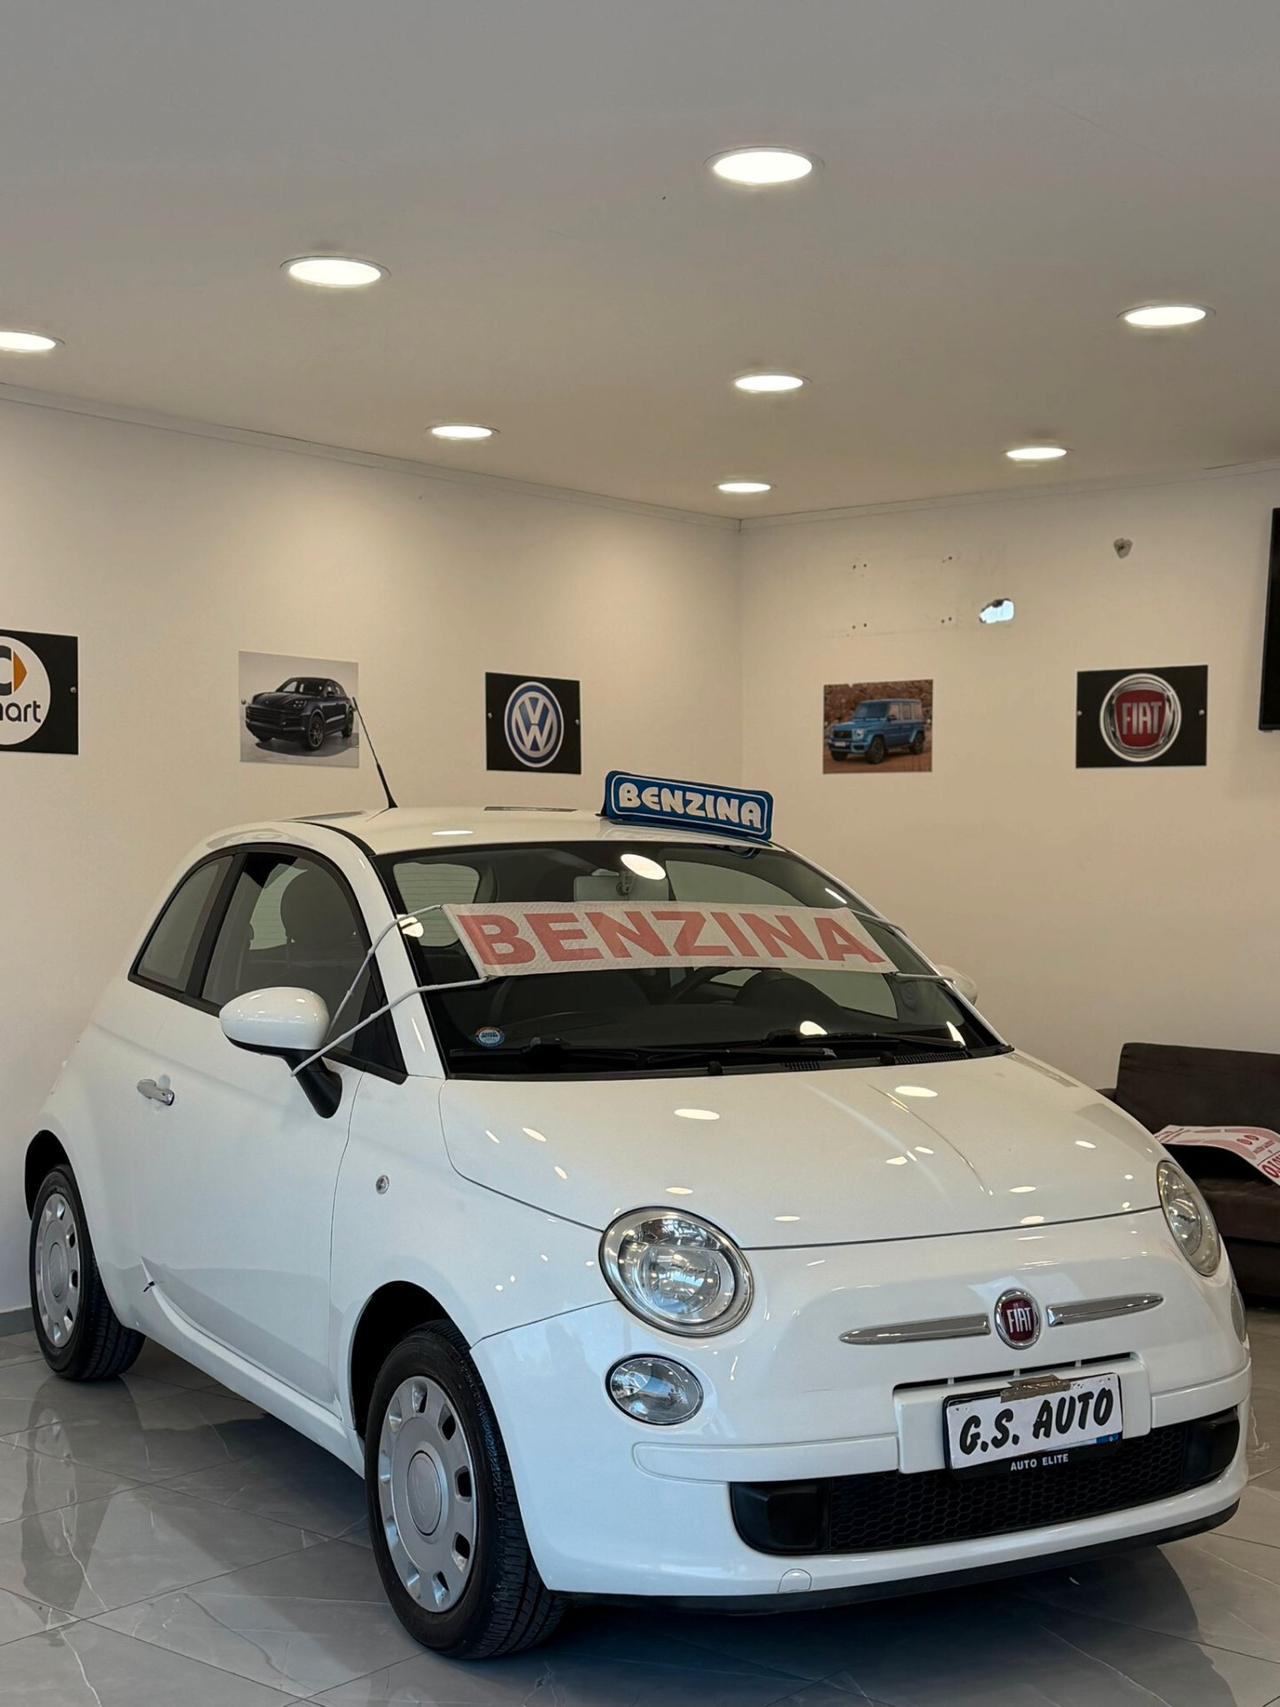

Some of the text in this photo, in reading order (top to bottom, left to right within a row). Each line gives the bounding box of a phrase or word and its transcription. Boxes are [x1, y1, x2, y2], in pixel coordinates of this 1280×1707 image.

[0, 700, 41, 723] art
[1121, 701, 1162, 735] FIAT
[618, 782, 762, 829] BENZINA
[457, 911, 887, 965] BENZINA
[1006, 1307, 1032, 1333] FIAT
[959, 1387, 1114, 1455] G.S. AUTO
[1010, 1453, 1069, 1471] AUTO ELITE
